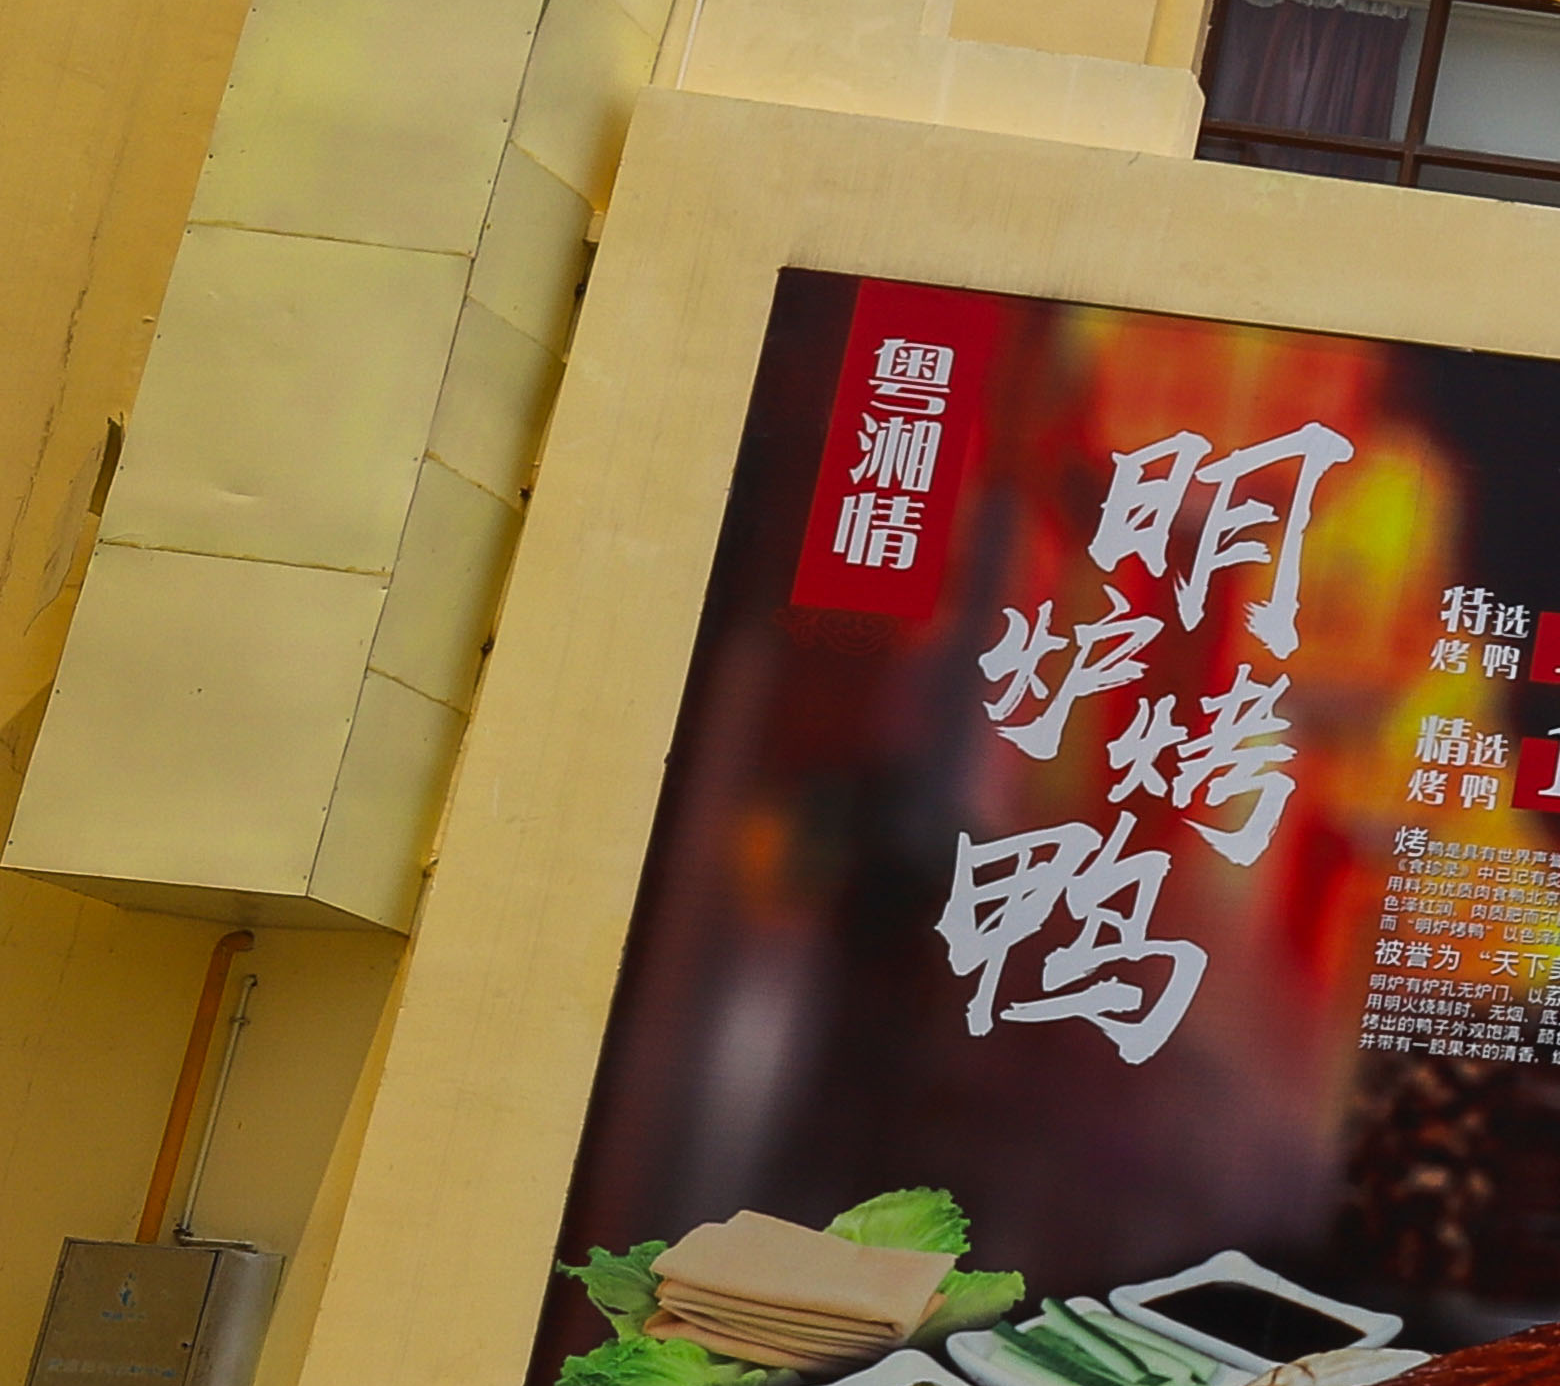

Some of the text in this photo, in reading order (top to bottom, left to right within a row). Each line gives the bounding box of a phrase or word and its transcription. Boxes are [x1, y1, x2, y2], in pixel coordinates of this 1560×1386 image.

[833, 338, 954, 570] 粤湘情
[1439, 585, 1530, 639] 特选
[1428, 639, 1521, 681] 烤鸭
[936, 422, 1354, 1065] 明炉烤鸭
[1415, 715, 1509, 769] 精选
[1406, 769, 1499, 811] 烤鸭
